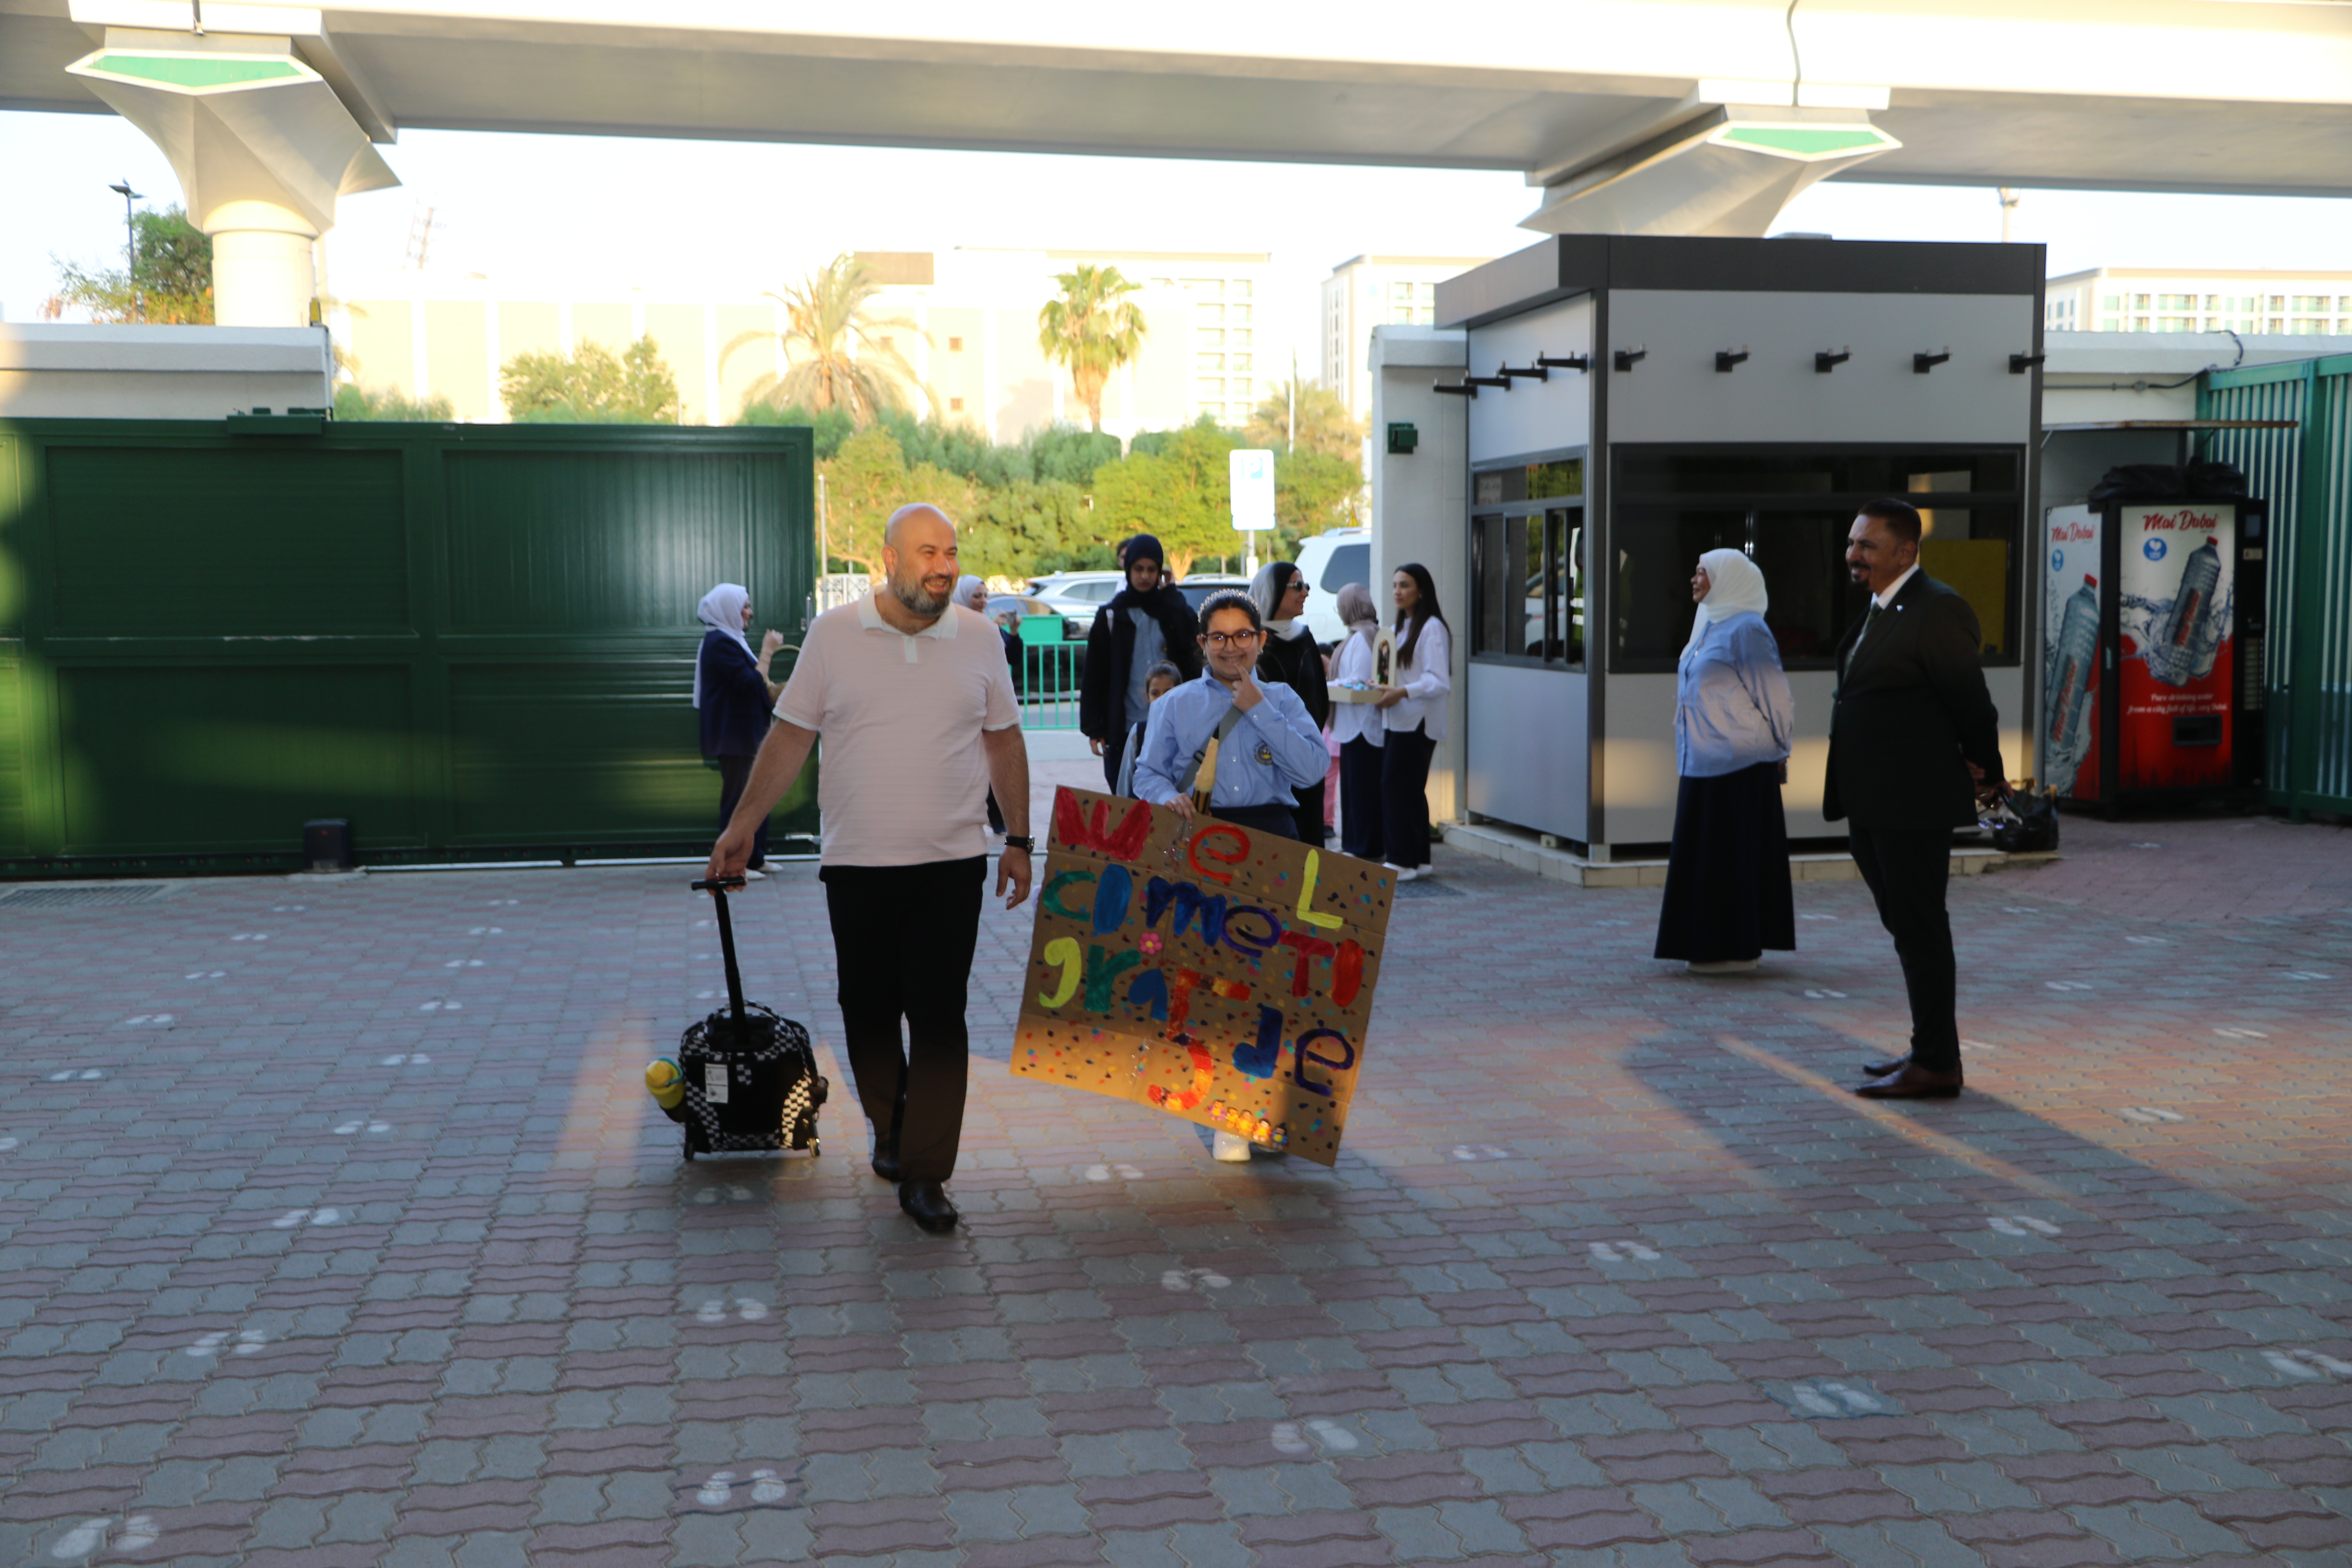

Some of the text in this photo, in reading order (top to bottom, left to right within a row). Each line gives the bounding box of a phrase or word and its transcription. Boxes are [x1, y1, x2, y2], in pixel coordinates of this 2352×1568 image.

[1243, 457, 1261, 479] P
[2142, 510, 2219, 531] Mai Dubai
[2051, 522, 2095, 542] Mai Dubai
